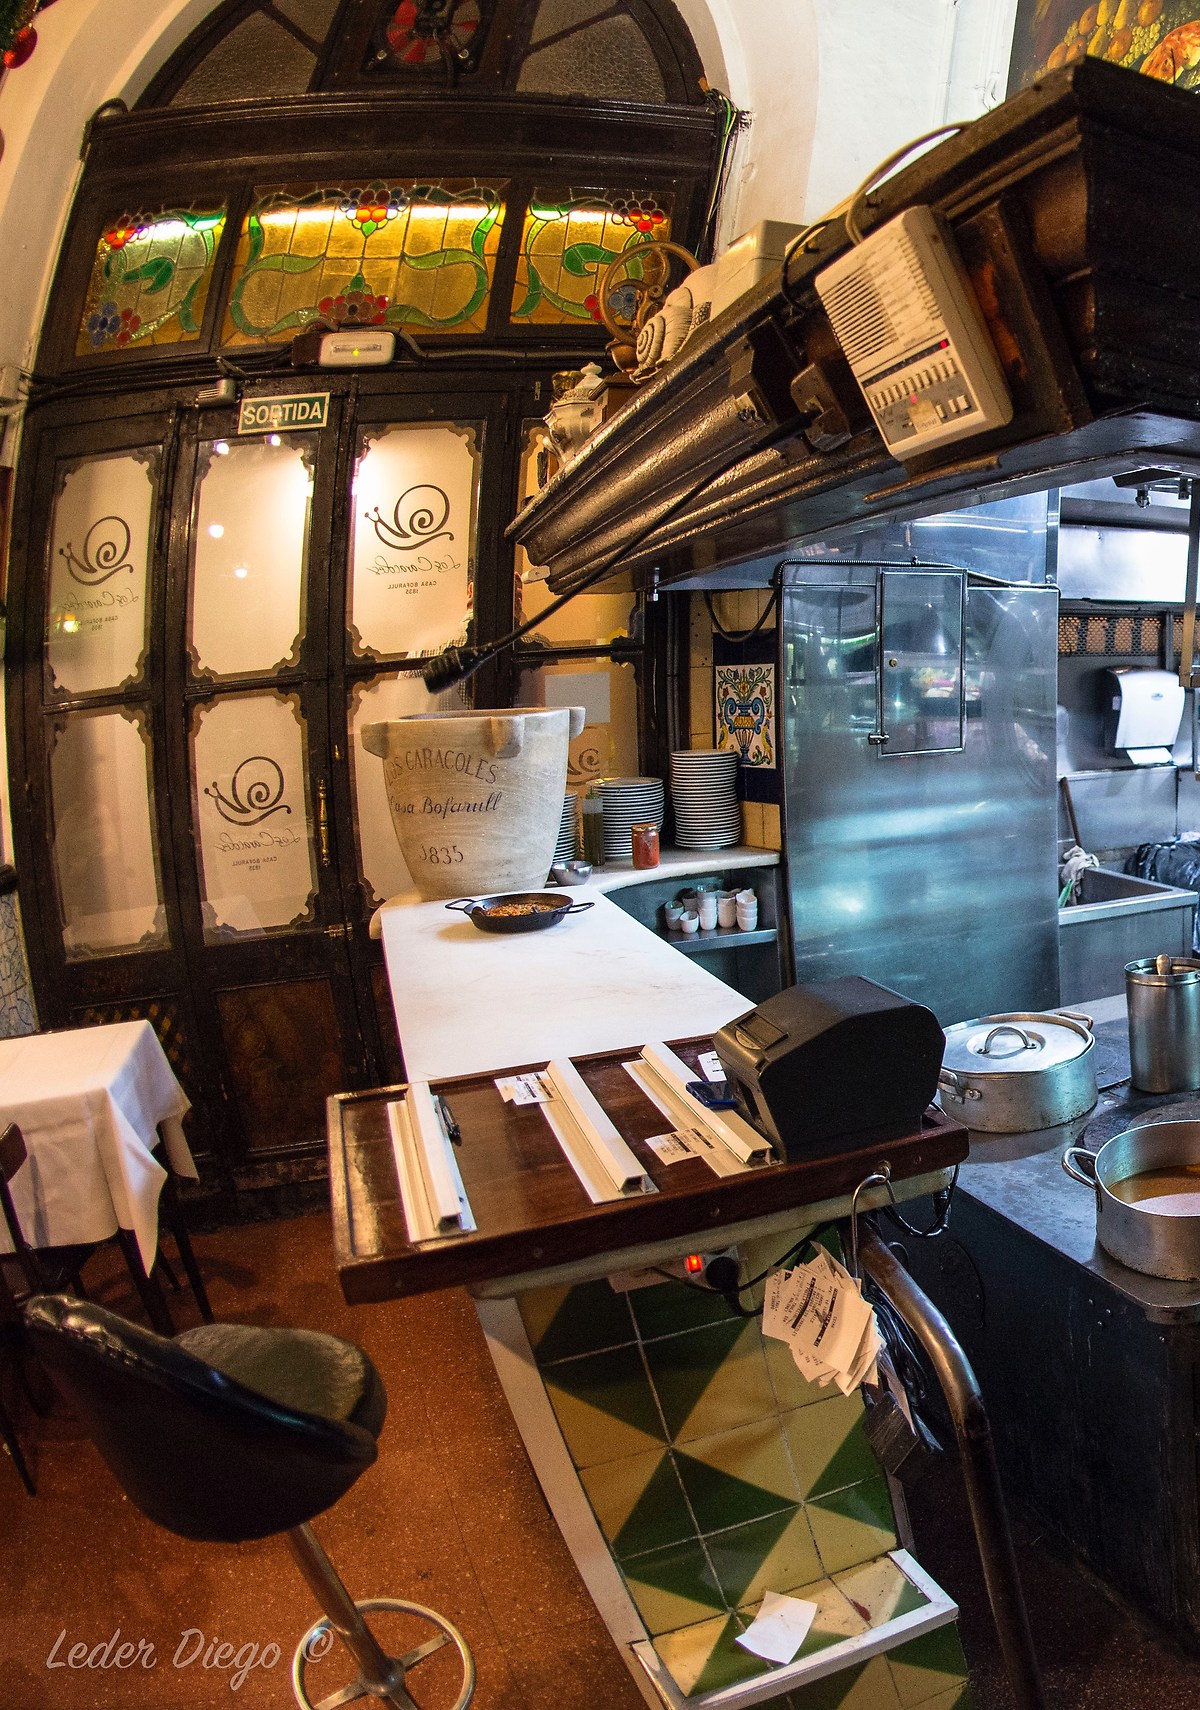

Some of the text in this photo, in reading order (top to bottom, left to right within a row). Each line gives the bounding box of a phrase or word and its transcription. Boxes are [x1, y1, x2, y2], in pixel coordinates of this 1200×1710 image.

[243, 401, 322, 425] SORTIDA
[405, 748, 500, 785] CARACOLES
[419, 791, 503, 820] Bofarull
[418, 844, 465, 865] 1835
